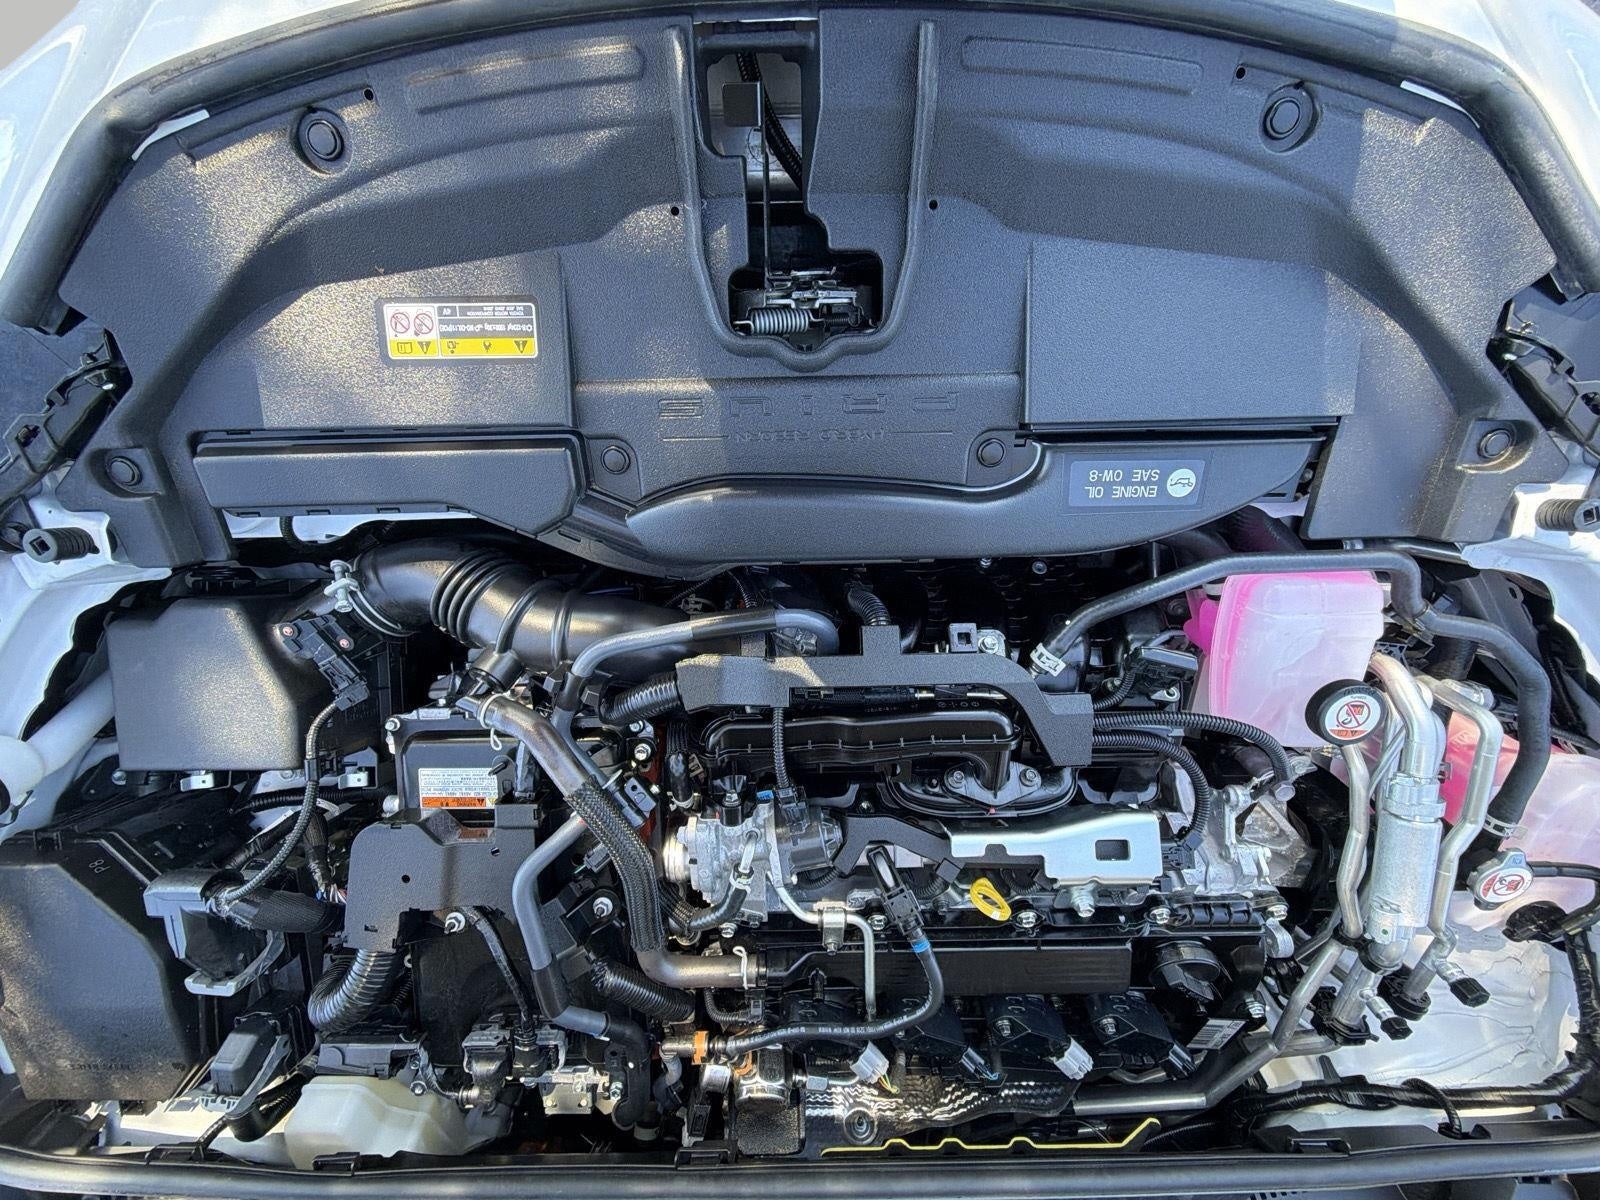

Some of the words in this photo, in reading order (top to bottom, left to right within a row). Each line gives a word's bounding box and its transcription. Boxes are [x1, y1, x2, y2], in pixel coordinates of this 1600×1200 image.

[657, 392, 958, 420] PRIUS
[1088, 469, 1123, 482] 0W-8
[1131, 469, 1160, 482] SAE
[1084, 486, 1104, 499] OIL
[1112, 485, 1158, 498] ENGINE
